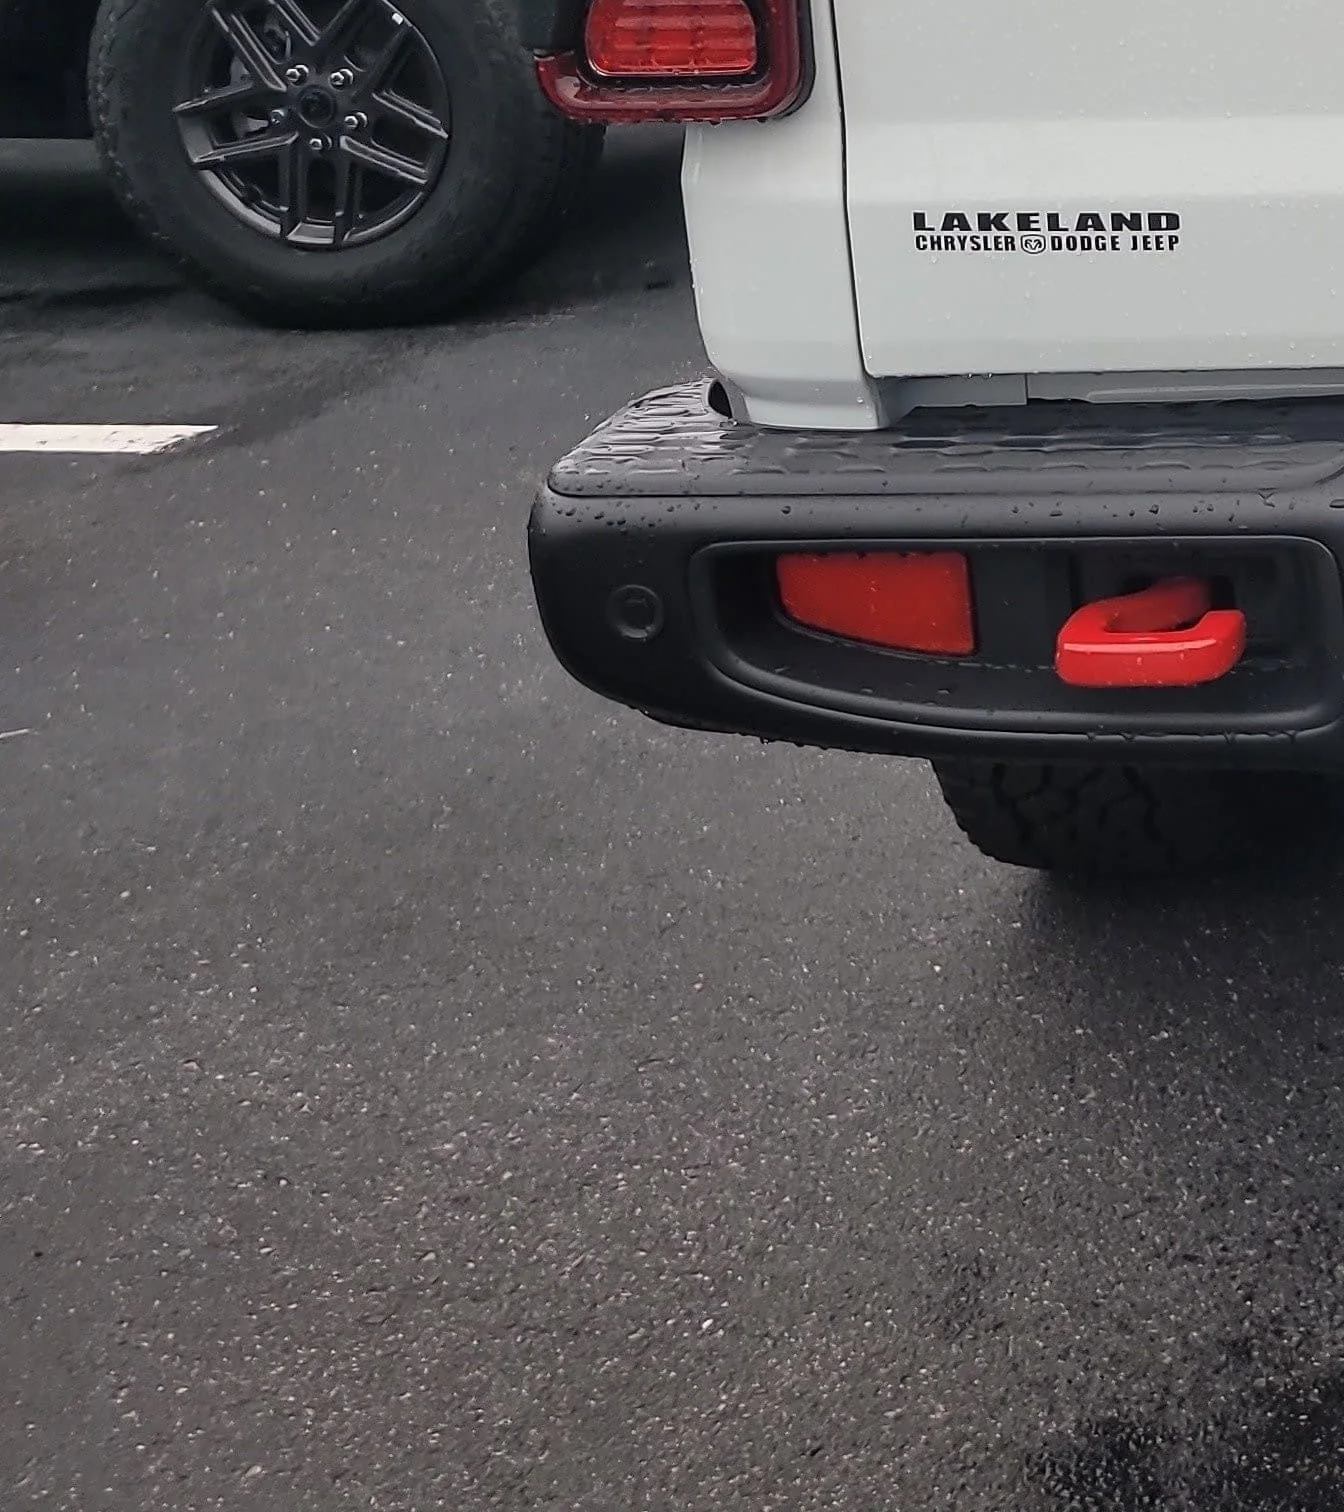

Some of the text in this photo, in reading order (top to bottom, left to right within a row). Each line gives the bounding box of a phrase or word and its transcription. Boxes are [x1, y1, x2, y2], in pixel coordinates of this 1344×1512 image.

[913, 212, 1180, 232] LAKELAND
[915, 234, 1179, 252] CHRYSLER DODGE JEEP
